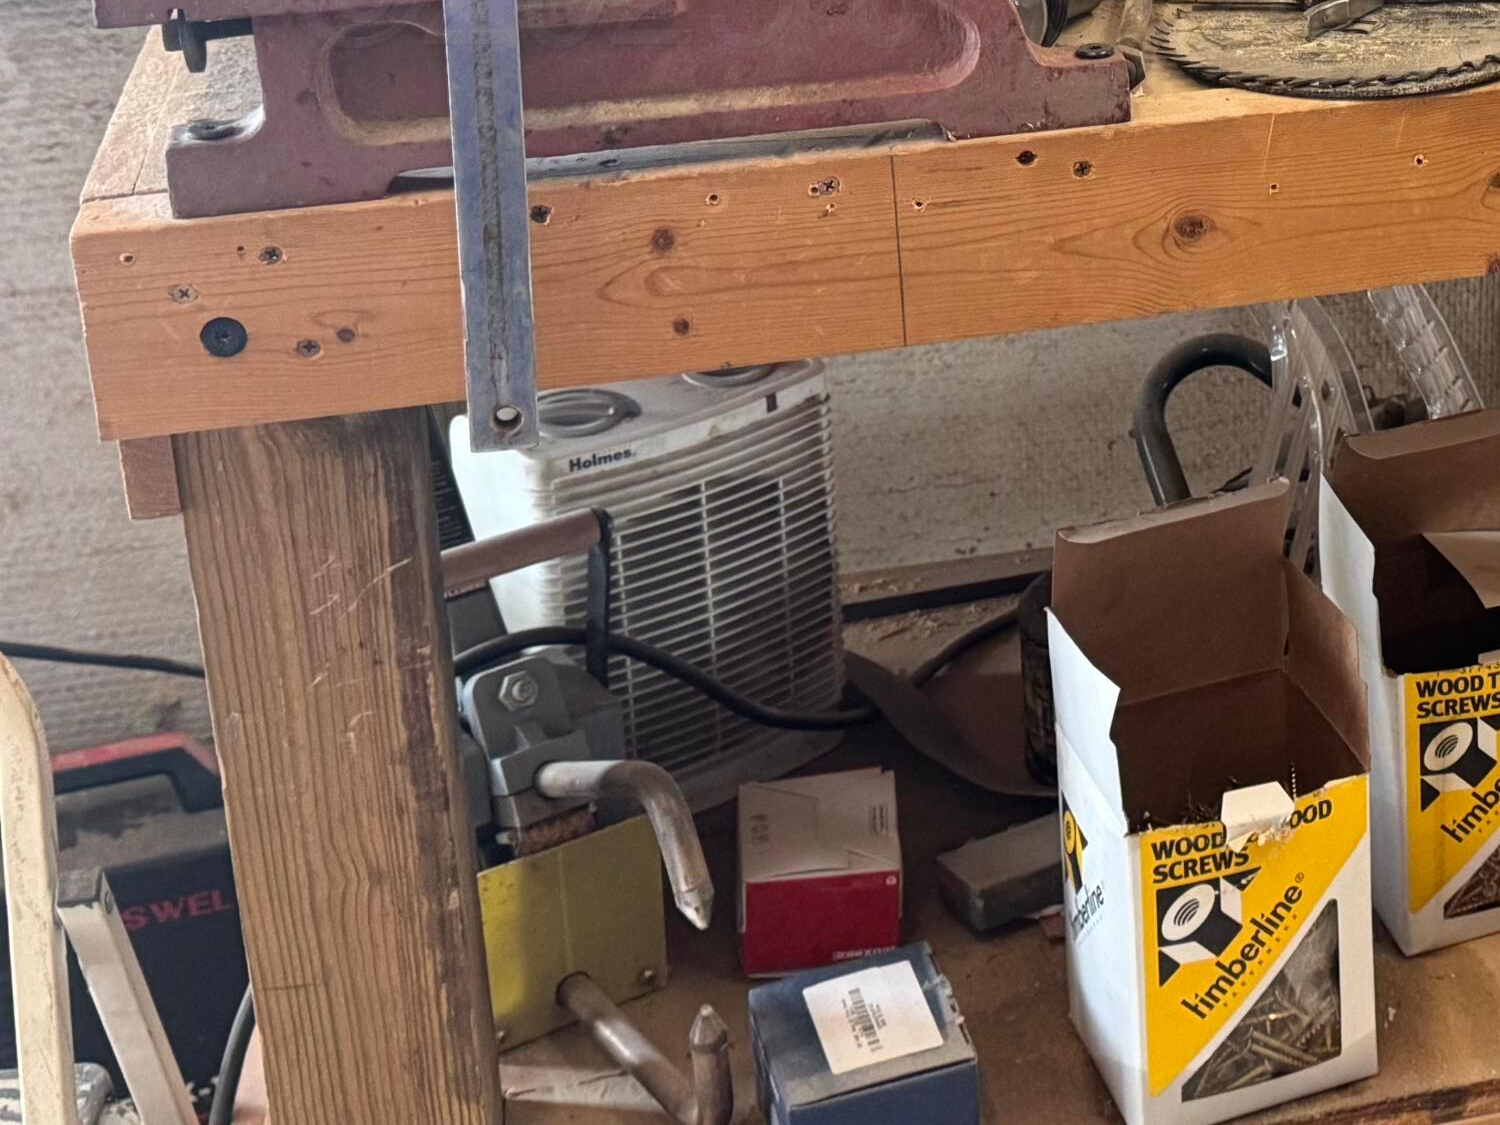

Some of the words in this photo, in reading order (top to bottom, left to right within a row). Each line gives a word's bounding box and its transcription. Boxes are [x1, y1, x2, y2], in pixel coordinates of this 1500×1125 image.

[568, 448, 632, 473] Holmes
[1415, 674, 1484, 699] WOOD
[1151, 831, 1226, 861] WOOD
[1151, 851, 1250, 885] SCREWS
